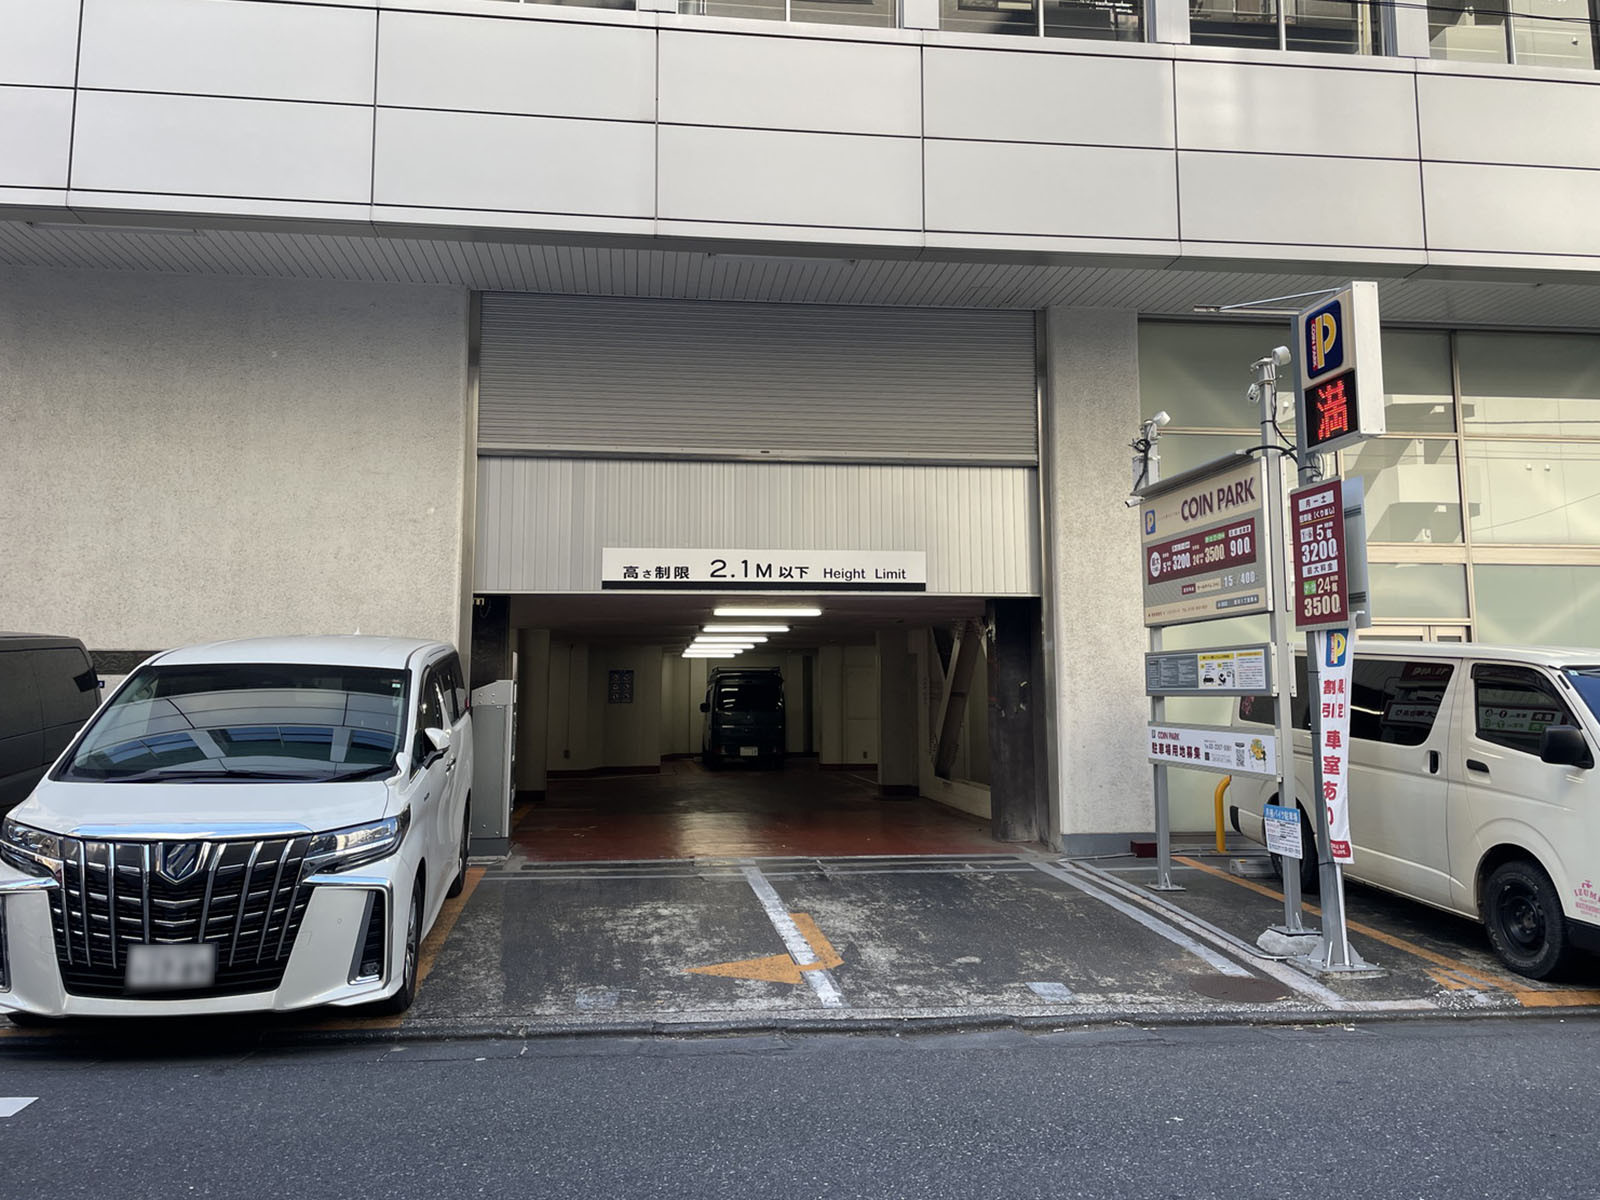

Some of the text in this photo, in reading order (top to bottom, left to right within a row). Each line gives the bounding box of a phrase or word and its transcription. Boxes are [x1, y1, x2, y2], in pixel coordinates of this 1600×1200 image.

[1317, 379, 1349, 441] 満
[1181, 476, 1256, 521] COIN PARK
[1316, 523, 1324, 541] 5
[1301, 538, 1338, 564] 3200
[623, 565, 690, 582] 高さ制限
[778, 565, 809, 580] 以下
[823, 567, 907, 582] Height Limit
[1317, 576, 1331, 594] 24
[1304, 593, 1341, 617] 3500
[1151, 741, 1201, 760] 駐車場用地募集
